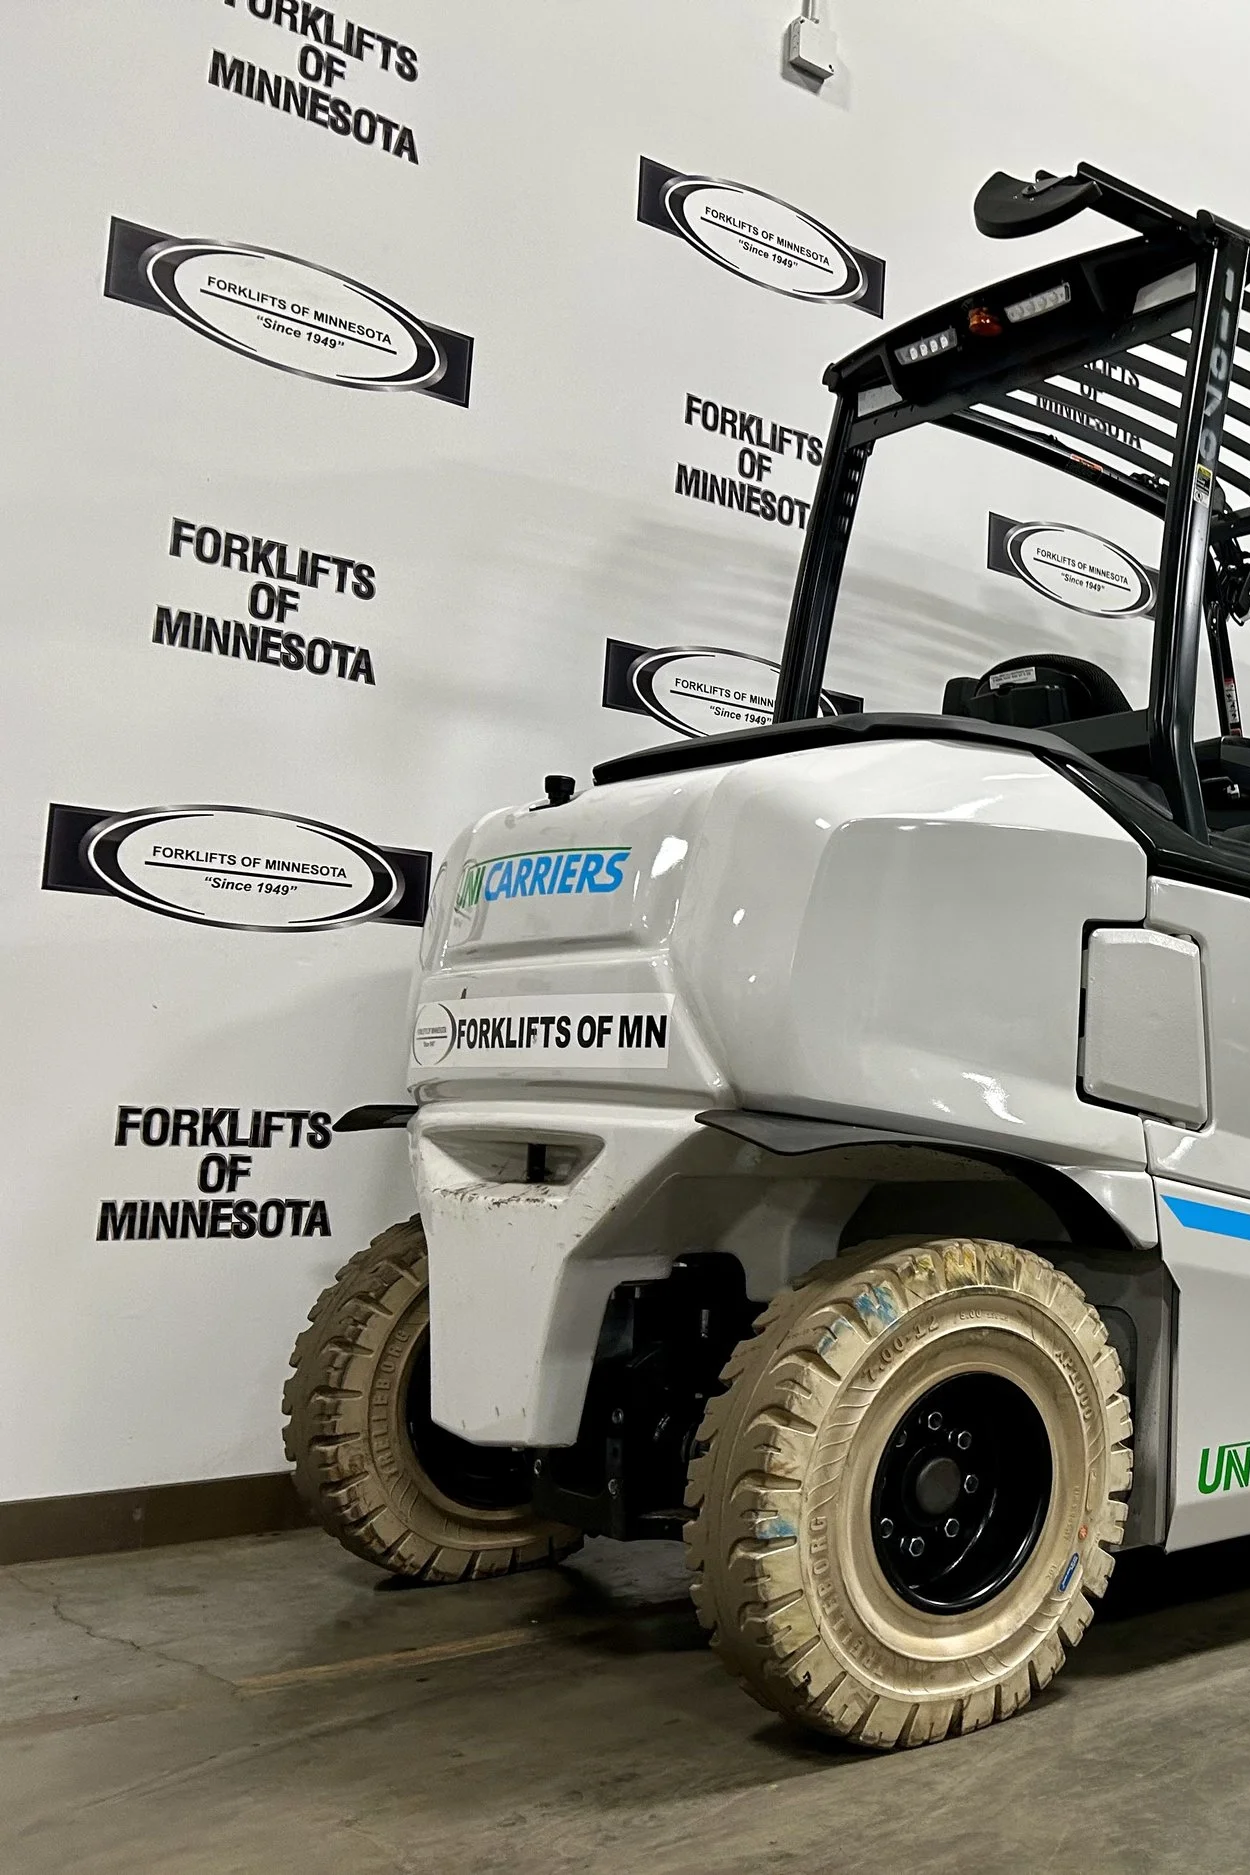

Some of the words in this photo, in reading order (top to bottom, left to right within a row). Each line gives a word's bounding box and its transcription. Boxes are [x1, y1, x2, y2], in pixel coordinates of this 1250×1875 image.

[224, 0, 419, 82] ORKLIFTS
[297, 44, 346, 87] OF
[208, 48, 419, 165] MINNESOTA
[705, 206, 759, 236] FORKLIFTS
[761, 230, 775, 242] OF
[776, 236, 830, 266] MINNESOTA
[207, 275, 287, 310] FORKLIFTS
[291, 303, 310, 317] OF
[313, 310, 392, 345] MINNESOTA
[684, 392, 823, 466] FORKLIFTS
[737, 447, 772, 482] OF
[675, 462, 811, 530] MINNESOT
[169, 517, 376, 601] FORKLIFTS
[1036, 547, 1076, 568] FORKLIFTS
[1077, 561, 1087, 570] OF
[1089, 565, 1129, 585] MINNESOTA
[248, 581, 300, 623] OF
[152, 604, 376, 686] MINNESOTA
[675, 677, 731, 698] FORKLIFTS
[733, 691, 747, 702] OF
[152, 845, 237, 866] FORKLIFTS
[241, 856, 261, 869] OF
[265, 859, 348, 879] MINNESOTA
[457, 1015, 571, 1049] FORKLIFTS
[577, 1015, 614, 1049] OF
[618, 1014, 668, 1048] MN
[114, 1105, 334, 1149] FORKLIFTS
[197, 1152, 253, 1194] OF
[96, 1198, 332, 1242] MINNESOTA
